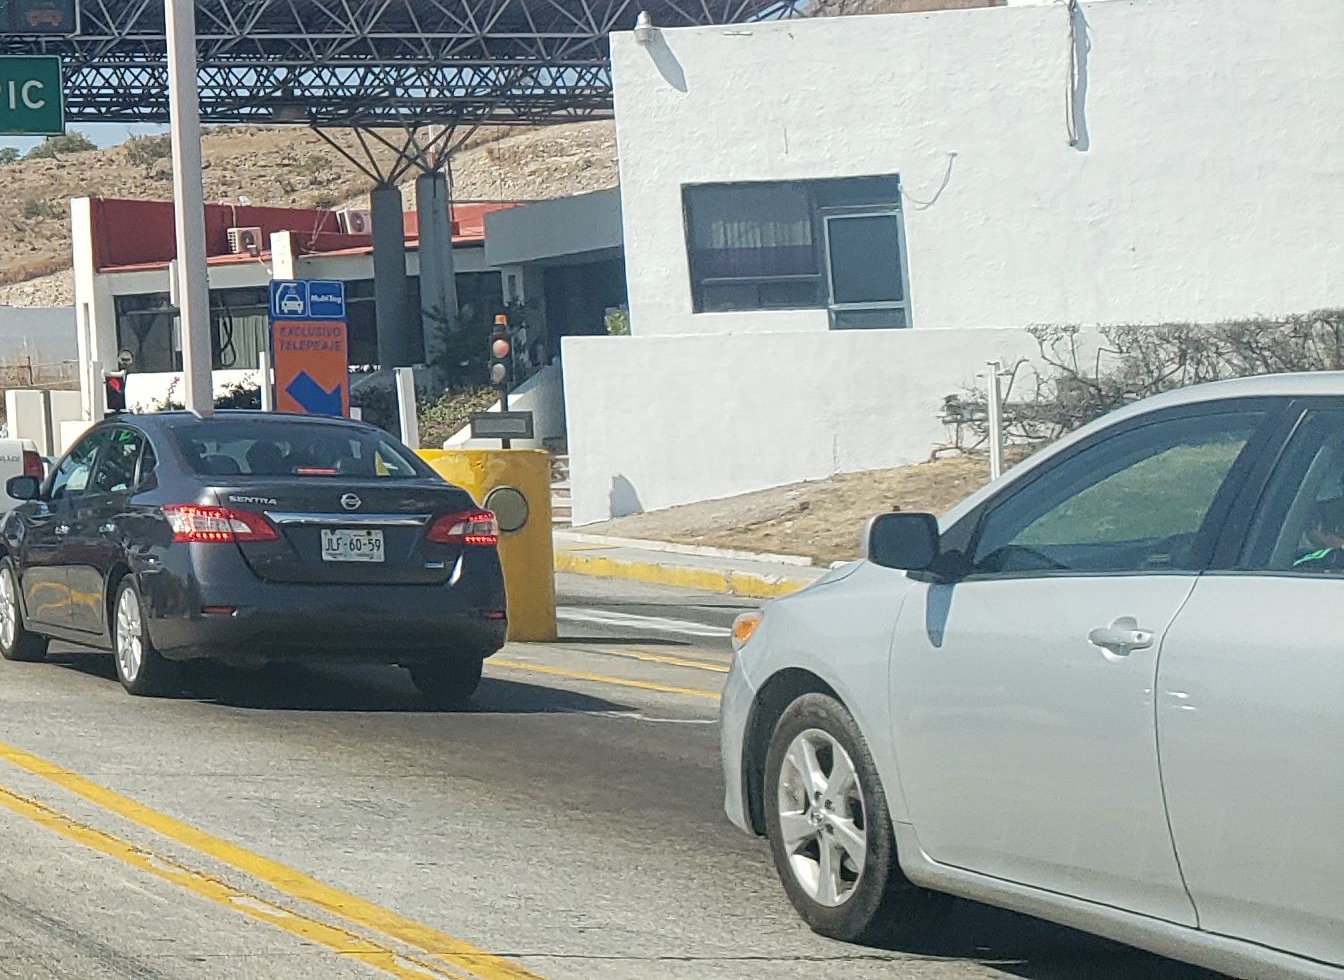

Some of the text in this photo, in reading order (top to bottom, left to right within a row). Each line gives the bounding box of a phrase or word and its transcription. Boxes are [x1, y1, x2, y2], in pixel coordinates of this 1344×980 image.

[279, 326, 341, 338] EXCLUSIVO
[279, 339, 342, 352] TELEPEAJE
[228, 494, 278, 506] SENTRA
[325, 537, 382, 552] JLF-60-59
